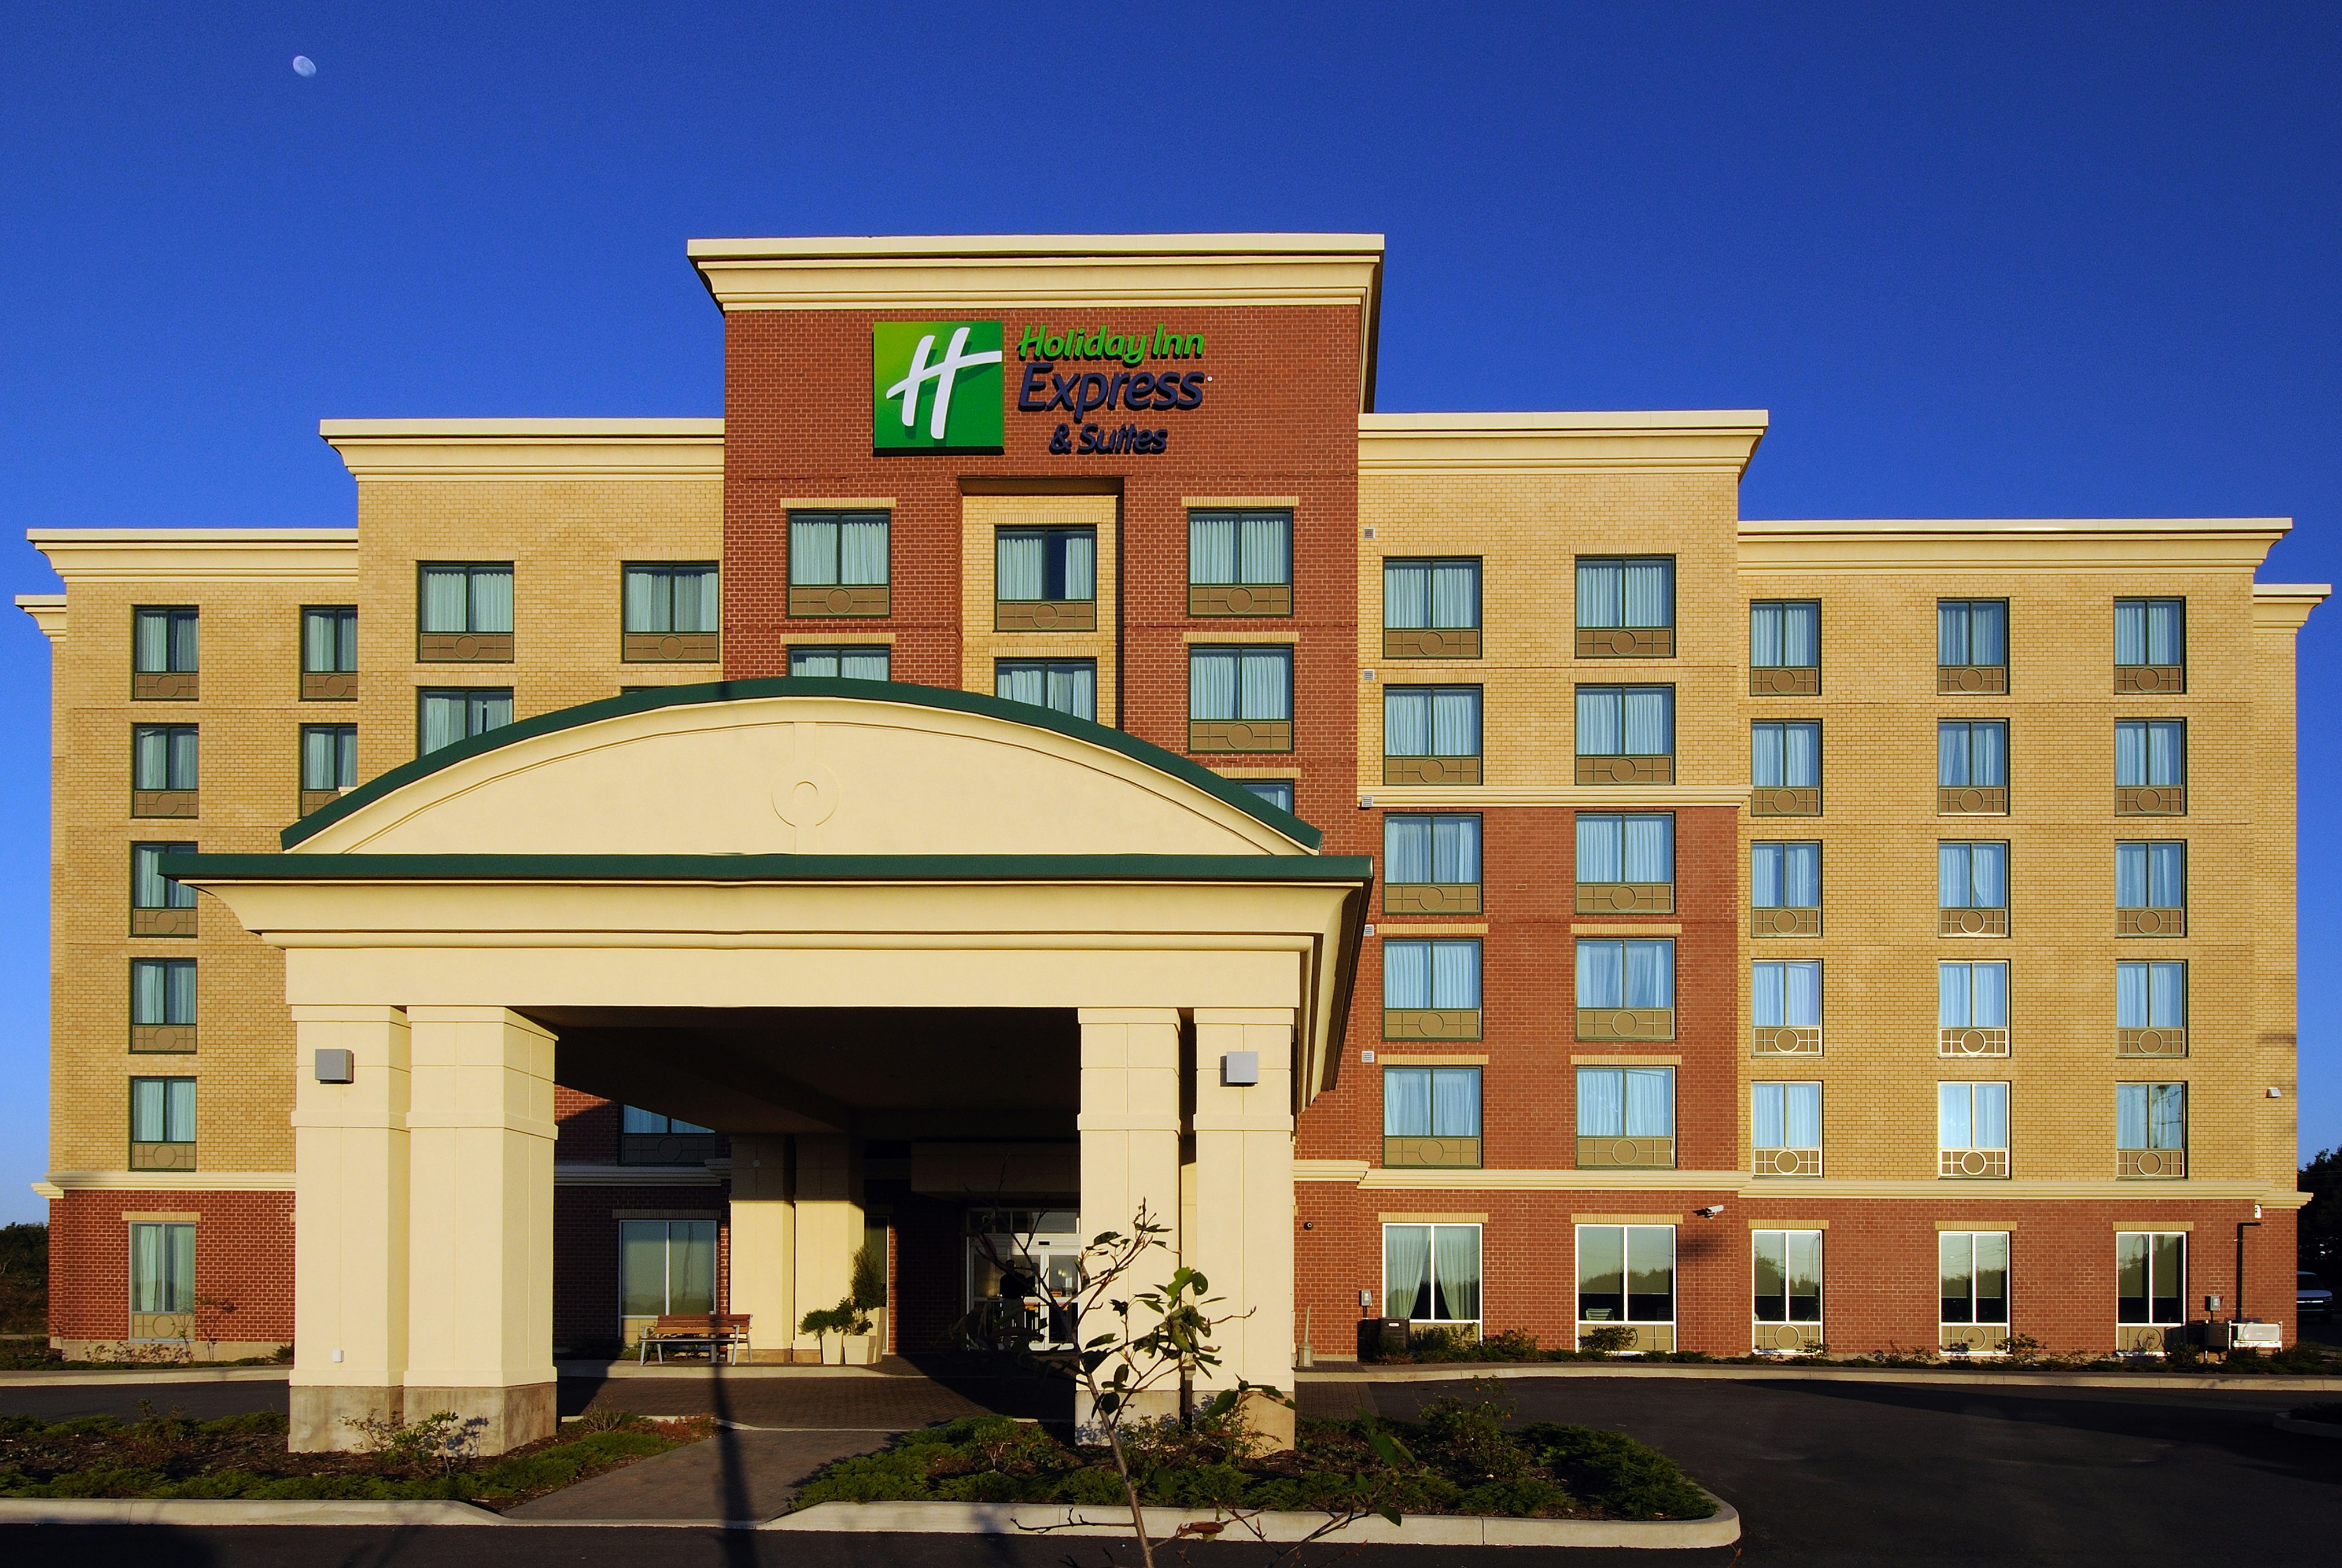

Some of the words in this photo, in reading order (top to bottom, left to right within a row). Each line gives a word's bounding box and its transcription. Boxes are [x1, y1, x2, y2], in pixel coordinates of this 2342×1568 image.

[1018, 324, 1148, 364] Holiday
[1152, 323, 1204, 356] Inn
[886, 327, 1002, 440] H
[1018, 362, 1205, 423] Express
[1050, 423, 1070, 454] &
[1078, 423, 1168, 455] Suites
